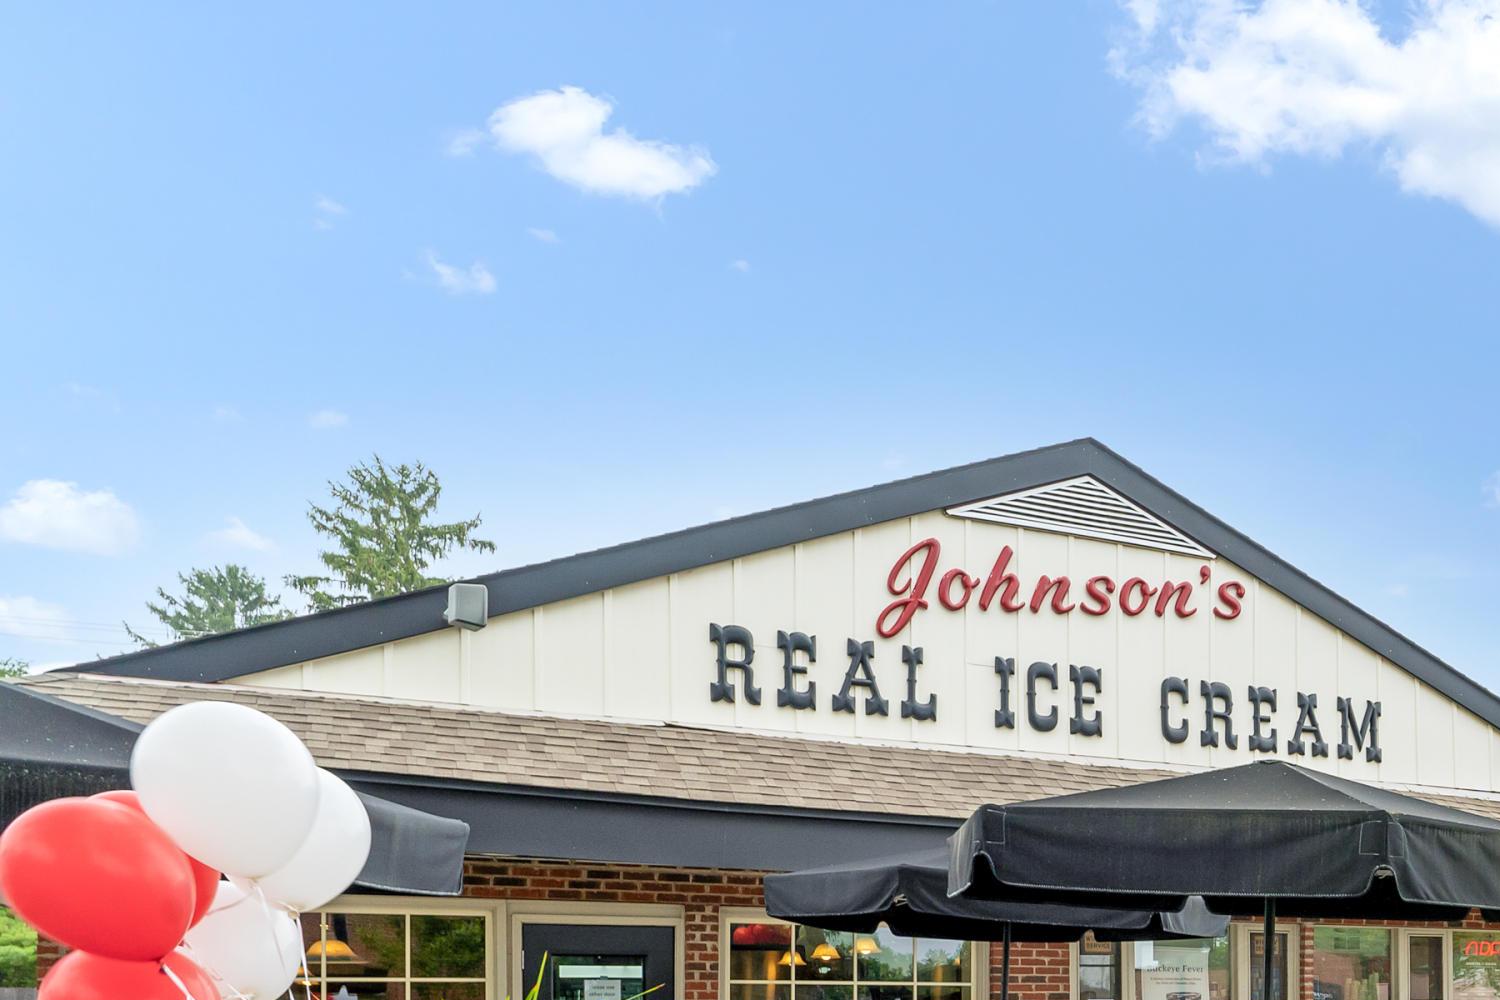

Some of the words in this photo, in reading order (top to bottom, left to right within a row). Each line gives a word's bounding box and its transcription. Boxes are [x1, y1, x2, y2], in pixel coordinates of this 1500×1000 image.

[876, 537, 1246, 638] Johnson's
[709, 622, 937, 723] REAL
[994, 655, 1102, 738] ICE
[1160, 675, 1382, 763] CREAM
[1182, 964, 1203, 973] Fever
